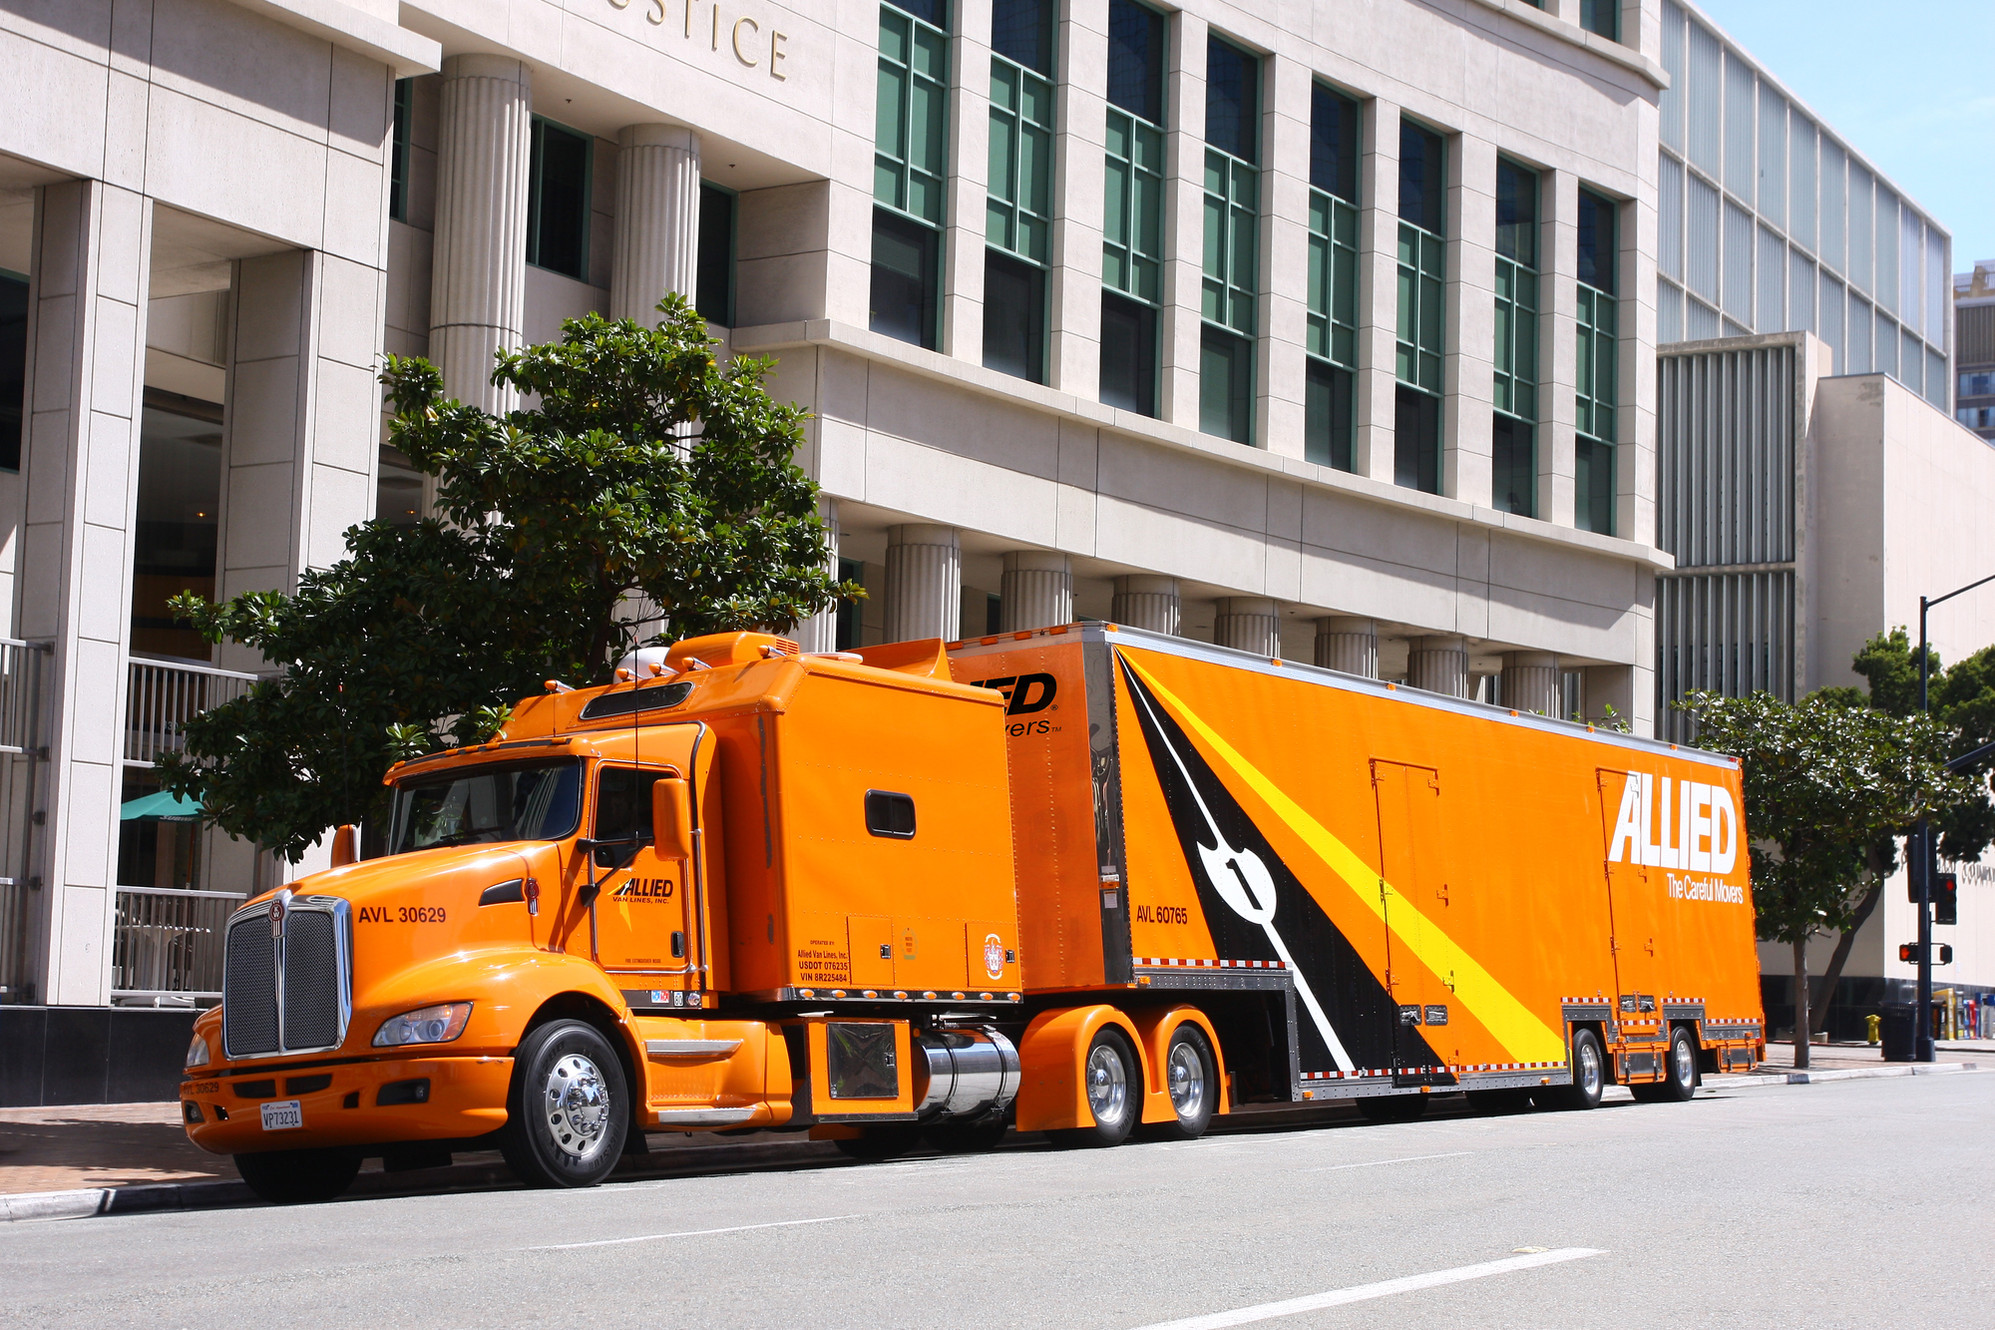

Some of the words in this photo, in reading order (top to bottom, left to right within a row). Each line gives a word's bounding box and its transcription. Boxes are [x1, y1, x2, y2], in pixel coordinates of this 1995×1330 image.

[607, 0, 788, 82] STICE
[1005, 720, 1050, 737] ers
[1608, 770, 1737, 875] ALLIED
[613, 878, 674, 898] ALLIED
[1666, 872, 1684, 899] The
[1684, 874, 1714, 902] Careful
[1714, 878, 1744, 905] Movers
[629, 897, 653, 905] LINES,
[358, 906, 393, 923] AVL
[399, 907, 446, 923] 30629
[1136, 904, 1155, 923] AVL
[1156, 906, 1188, 925] 60765
[798, 949, 812, 959] Allied
[812, 950, 823, 959] Van
[798, 960, 823, 970] USDOT
[824, 961, 848, 971] 076235
[800, 972, 813, 981] VIN
